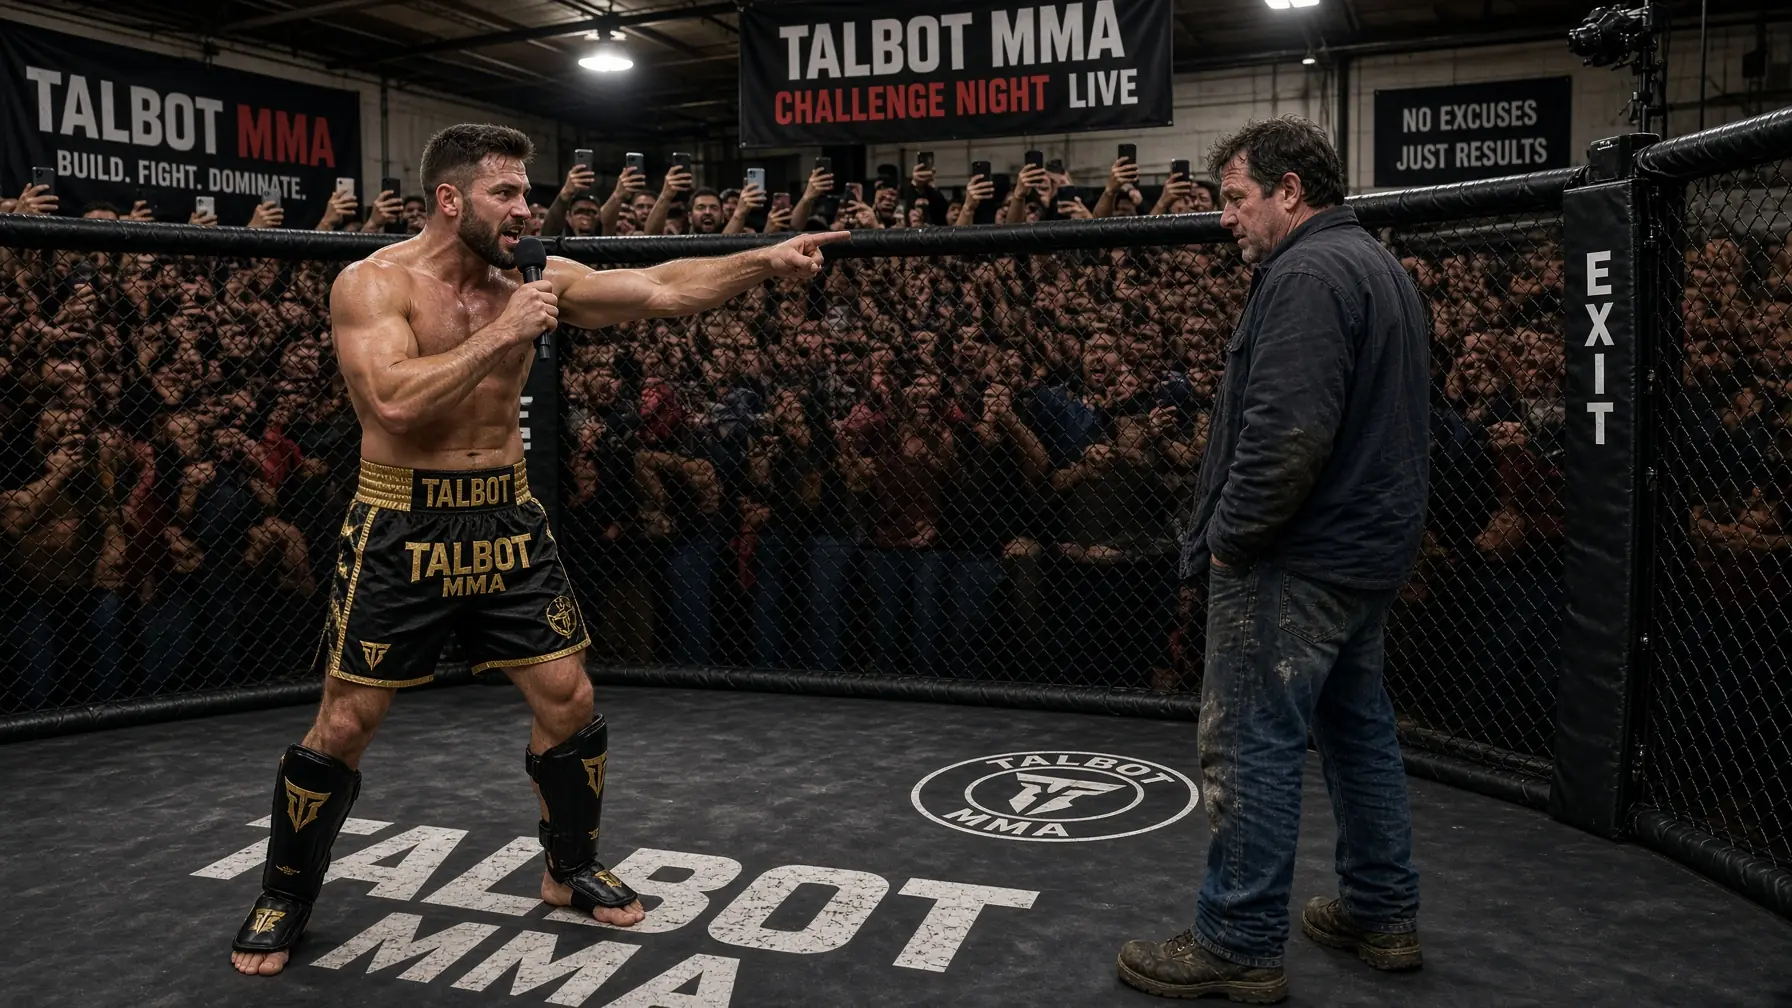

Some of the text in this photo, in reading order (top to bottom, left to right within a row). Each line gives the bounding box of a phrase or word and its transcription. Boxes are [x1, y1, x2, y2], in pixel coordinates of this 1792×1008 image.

[777, 0, 1125, 80] TALBOT MMA
[26, 65, 336, 168] TALBOT MMA
[775, 68, 1138, 125] CHALLENGE NIGHT LIVE
[1403, 100, 1537, 133] NO EXCUSES
[57, 150, 307, 200] BUILD. FIGHT. DOMINATE.
[1396, 137, 1548, 171] JUST RESULTS
[1584, 250, 1615, 445] EXIT
[422, 473, 511, 508] TALBOT
[405, 533, 532, 583] TALBOT
[442, 574, 506, 598] MMA
[985, 754, 1176, 785] TALBOT
[942, 807, 1070, 837] MMA
[310, 911, 742, 1008] MMA
